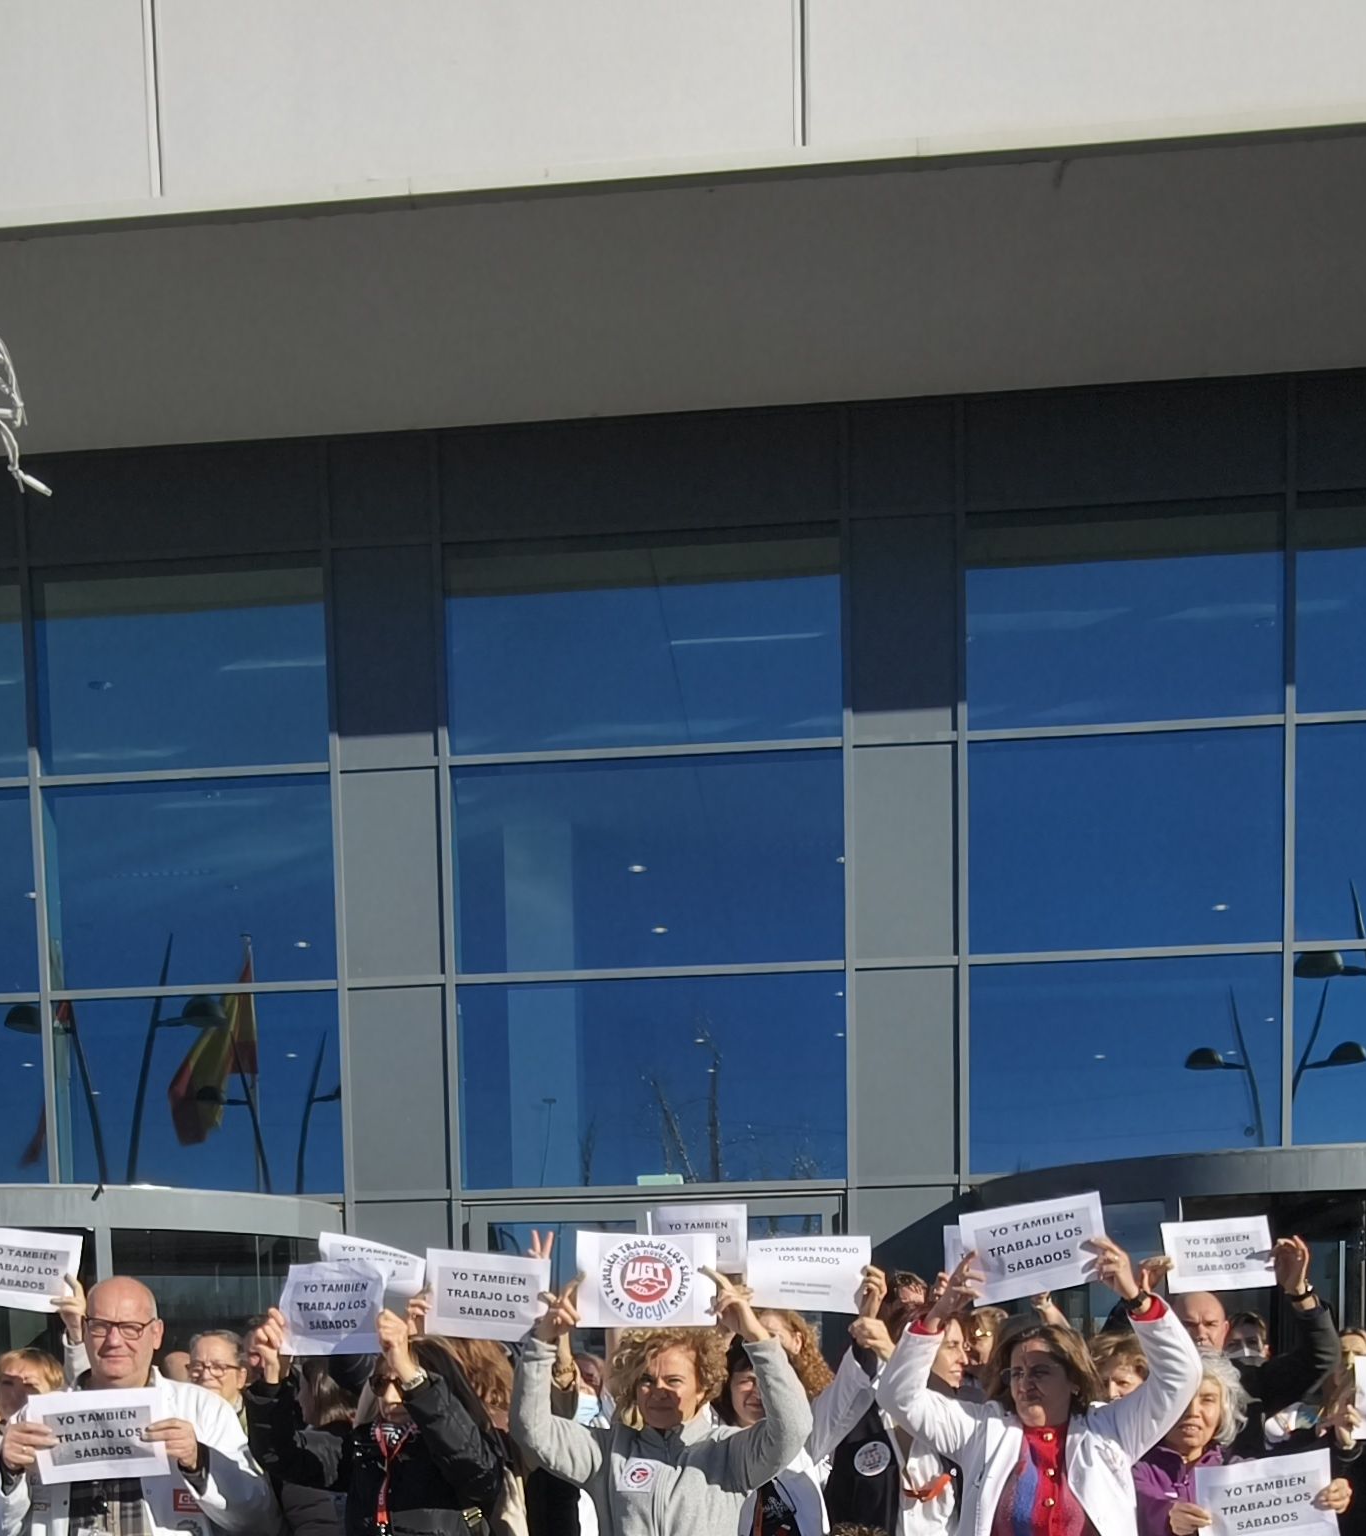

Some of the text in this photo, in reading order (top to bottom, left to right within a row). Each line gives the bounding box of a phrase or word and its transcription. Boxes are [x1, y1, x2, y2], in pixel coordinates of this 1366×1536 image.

[669, 1223, 682, 1231] YO
[989, 1226, 1009, 1238] YO
[716, 1235, 732, 1244] OS
[988, 1225, 1083, 1258] TRABAJO LOS
[1185, 1237, 1201, 1246] YO
[617, 1239, 667, 1254] TRABAJO
[667, 1247, 685, 1264] LOS
[819, 1246, 859, 1254] TRABAJO
[1184, 1246, 1256, 1259] TRABAJO LOS
[1007, 1248, 1072, 1273] SÁBADOS
[1197, 1260, 1246, 1273] SÁBADOS
[38, 1266, 59, 1276] LOS
[626, 1261, 666, 1281] UGT
[452, 1272, 526, 1286] YO TAMBIÉN
[303, 1281, 369, 1293] YO TAMBIÉN
[447, 1288, 530, 1304] TRABAJO LOS
[297, 1299, 367, 1311] TRABAJO LOS
[459, 1305, 516, 1319] SÁBADOS
[309, 1319, 358, 1331] SÁBADOS
[57, 1410, 137, 1426] YO TAMBIÉN
[56, 1427, 142, 1444] TRABAJO LOS
[1224, 1475, 1307, 1498] YO TAMBIÉN
[1221, 1492, 1312, 1516] TRABAJO LOS
[1236, 1512, 1299, 1531] SÁBADOS
